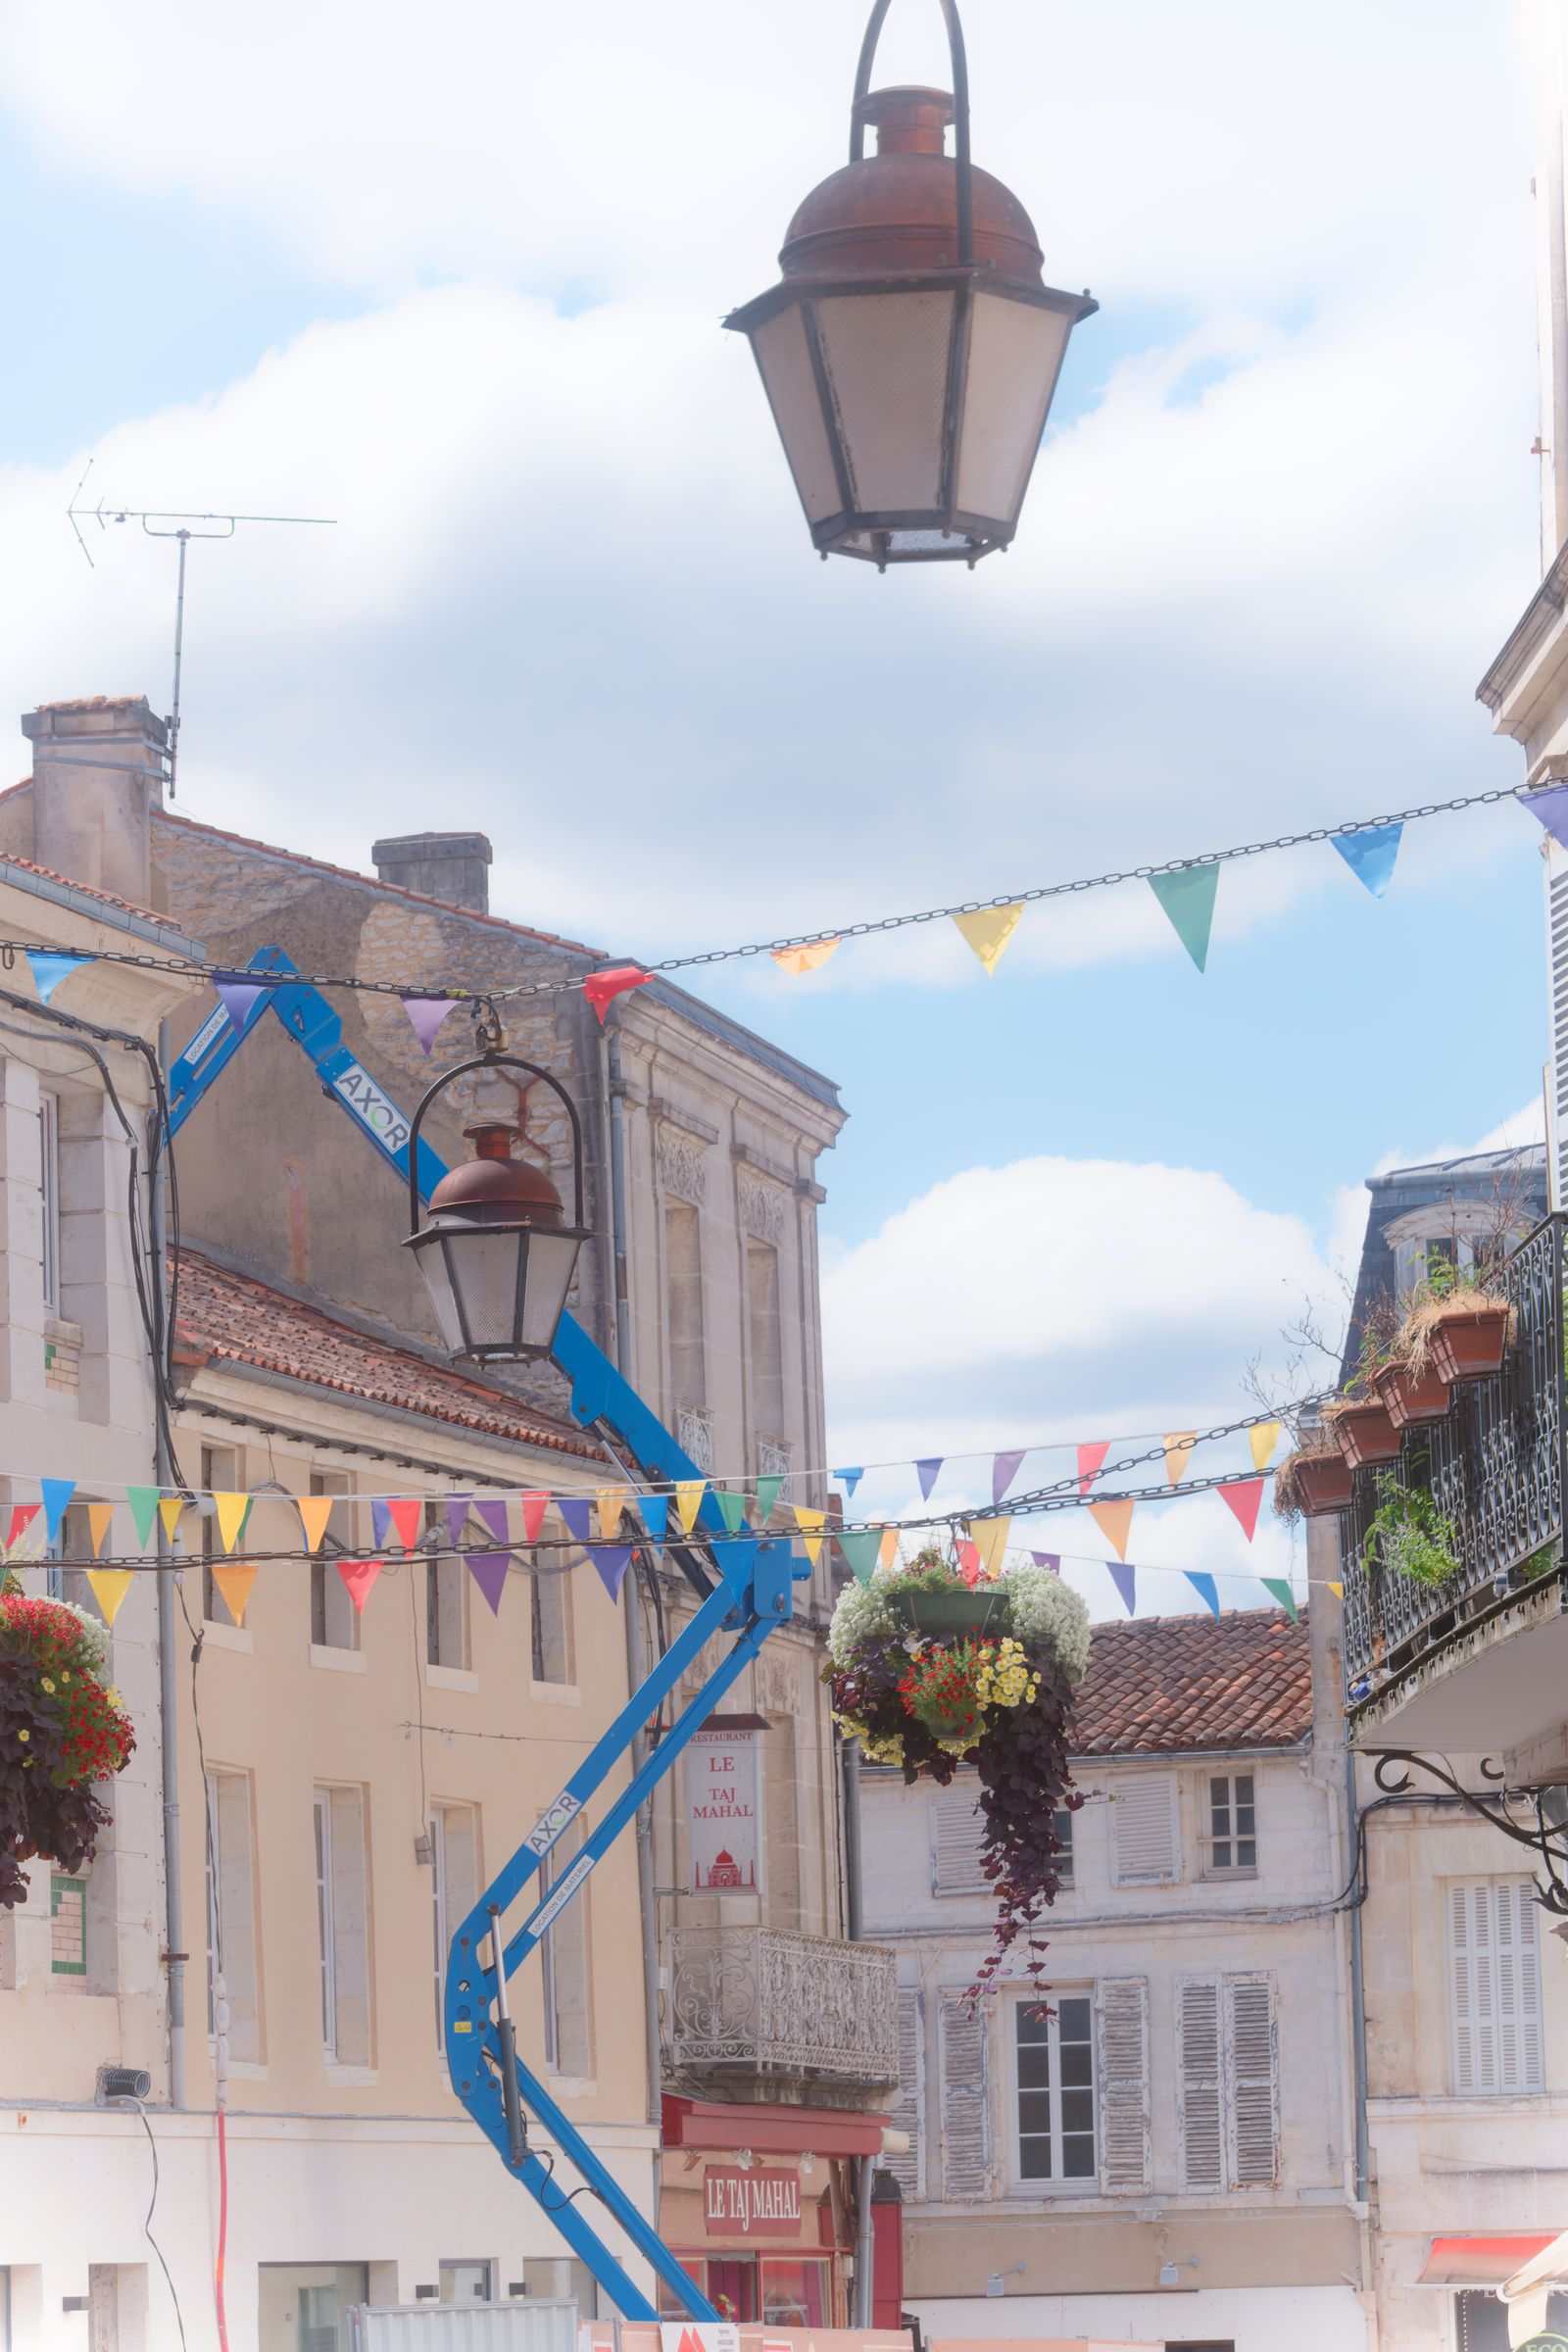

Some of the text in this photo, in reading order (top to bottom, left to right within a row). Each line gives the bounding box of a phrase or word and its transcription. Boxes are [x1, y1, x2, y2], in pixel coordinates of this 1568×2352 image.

[188, 1027, 214, 1061] LOCATION
[339, 1074, 409, 1148] AXOR
[690, 1732, 753, 1742] RESTAURANT
[709, 1757, 735, 1772] LE
[693, 1805, 754, 1819] MAHAL
[709, 1788, 736, 1803] TAJ
[530, 1796, 578, 1852] AXOR
[531, 1901, 559, 1934] LOCATION
[557, 1890, 566, 1902] DE
[708, 2179, 801, 2231] LE TAJ MAHAL
